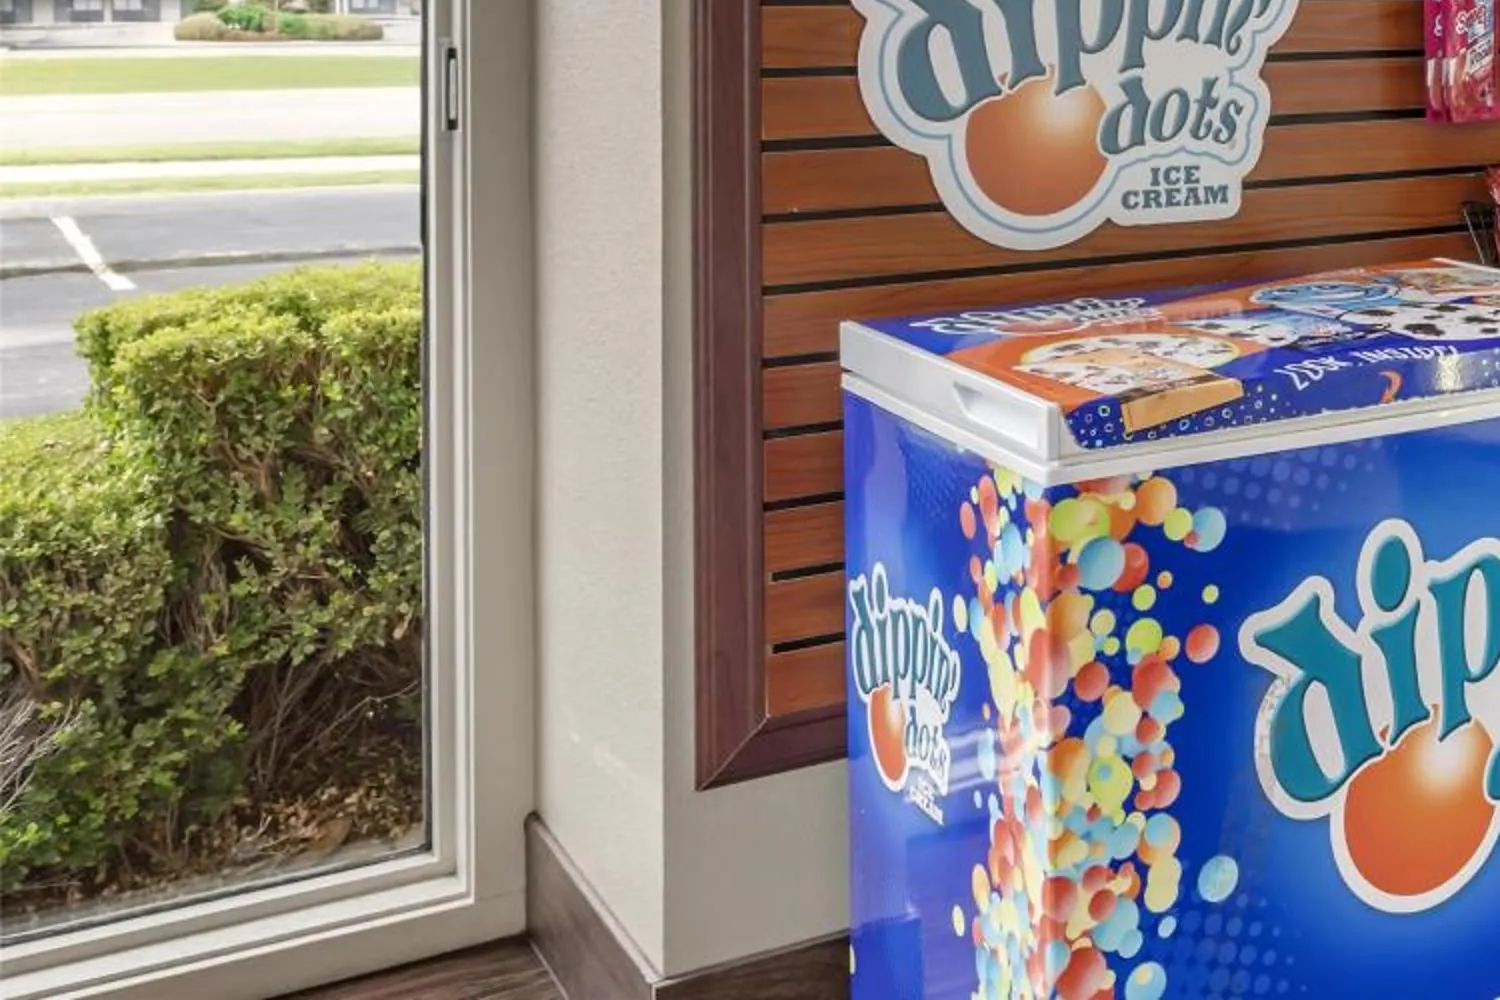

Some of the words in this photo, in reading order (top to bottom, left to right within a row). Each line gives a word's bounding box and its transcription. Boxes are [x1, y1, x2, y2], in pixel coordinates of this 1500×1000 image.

[1100, 76, 1244, 156] dots
[1120, 184, 1230, 211] CREAM
[1149, 165, 1202, 187] ICE
[1274, 355, 1347, 392] LOOK
[850, 571, 957, 714] dippin'
[905, 703, 947, 778] dots
